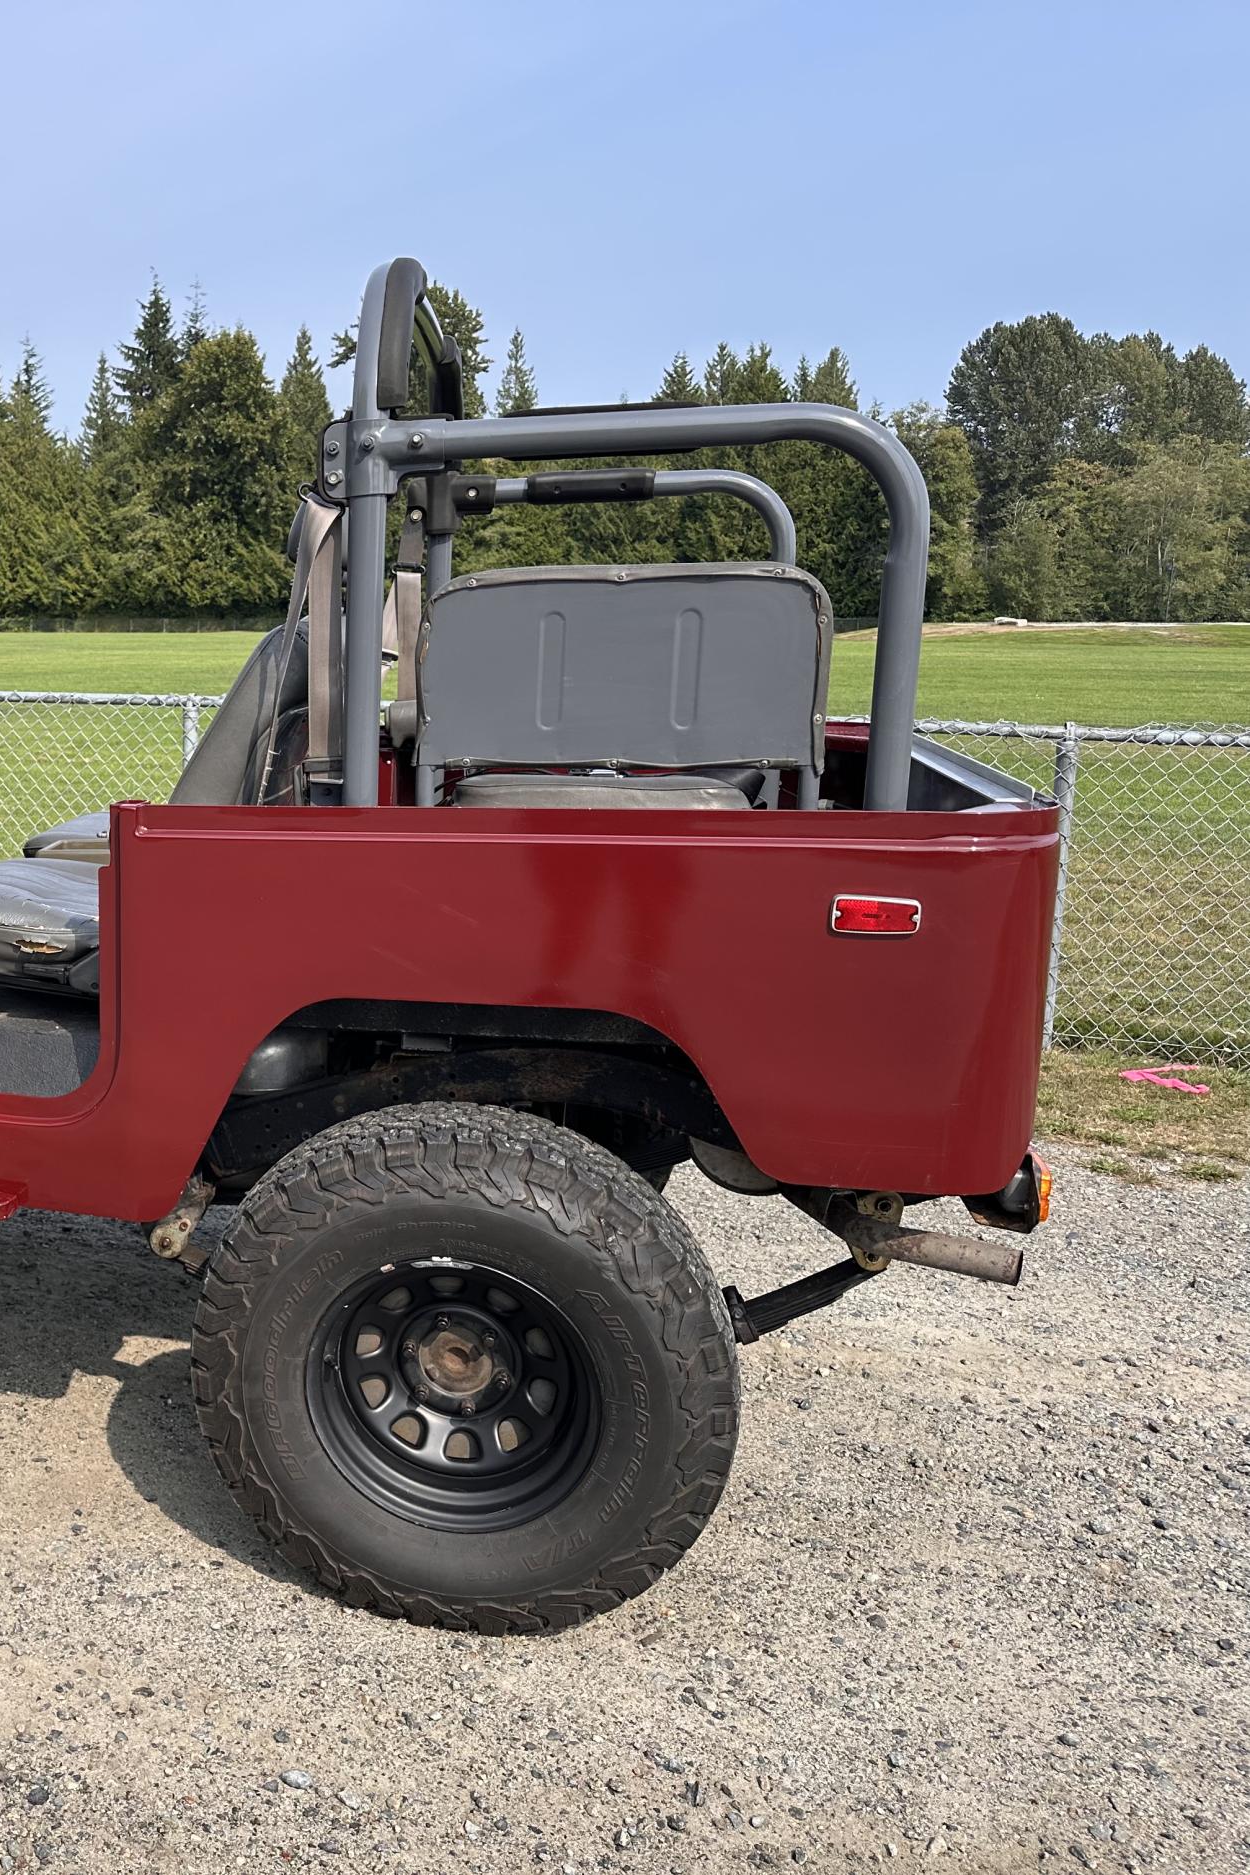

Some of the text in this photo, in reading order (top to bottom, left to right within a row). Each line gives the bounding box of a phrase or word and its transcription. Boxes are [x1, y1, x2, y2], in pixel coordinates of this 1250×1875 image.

[257, 1248, 345, 1482] BFGoodrich
[575, 1288, 652, 1524] All-Terrain
[523, 1529, 593, 1573] T/A
